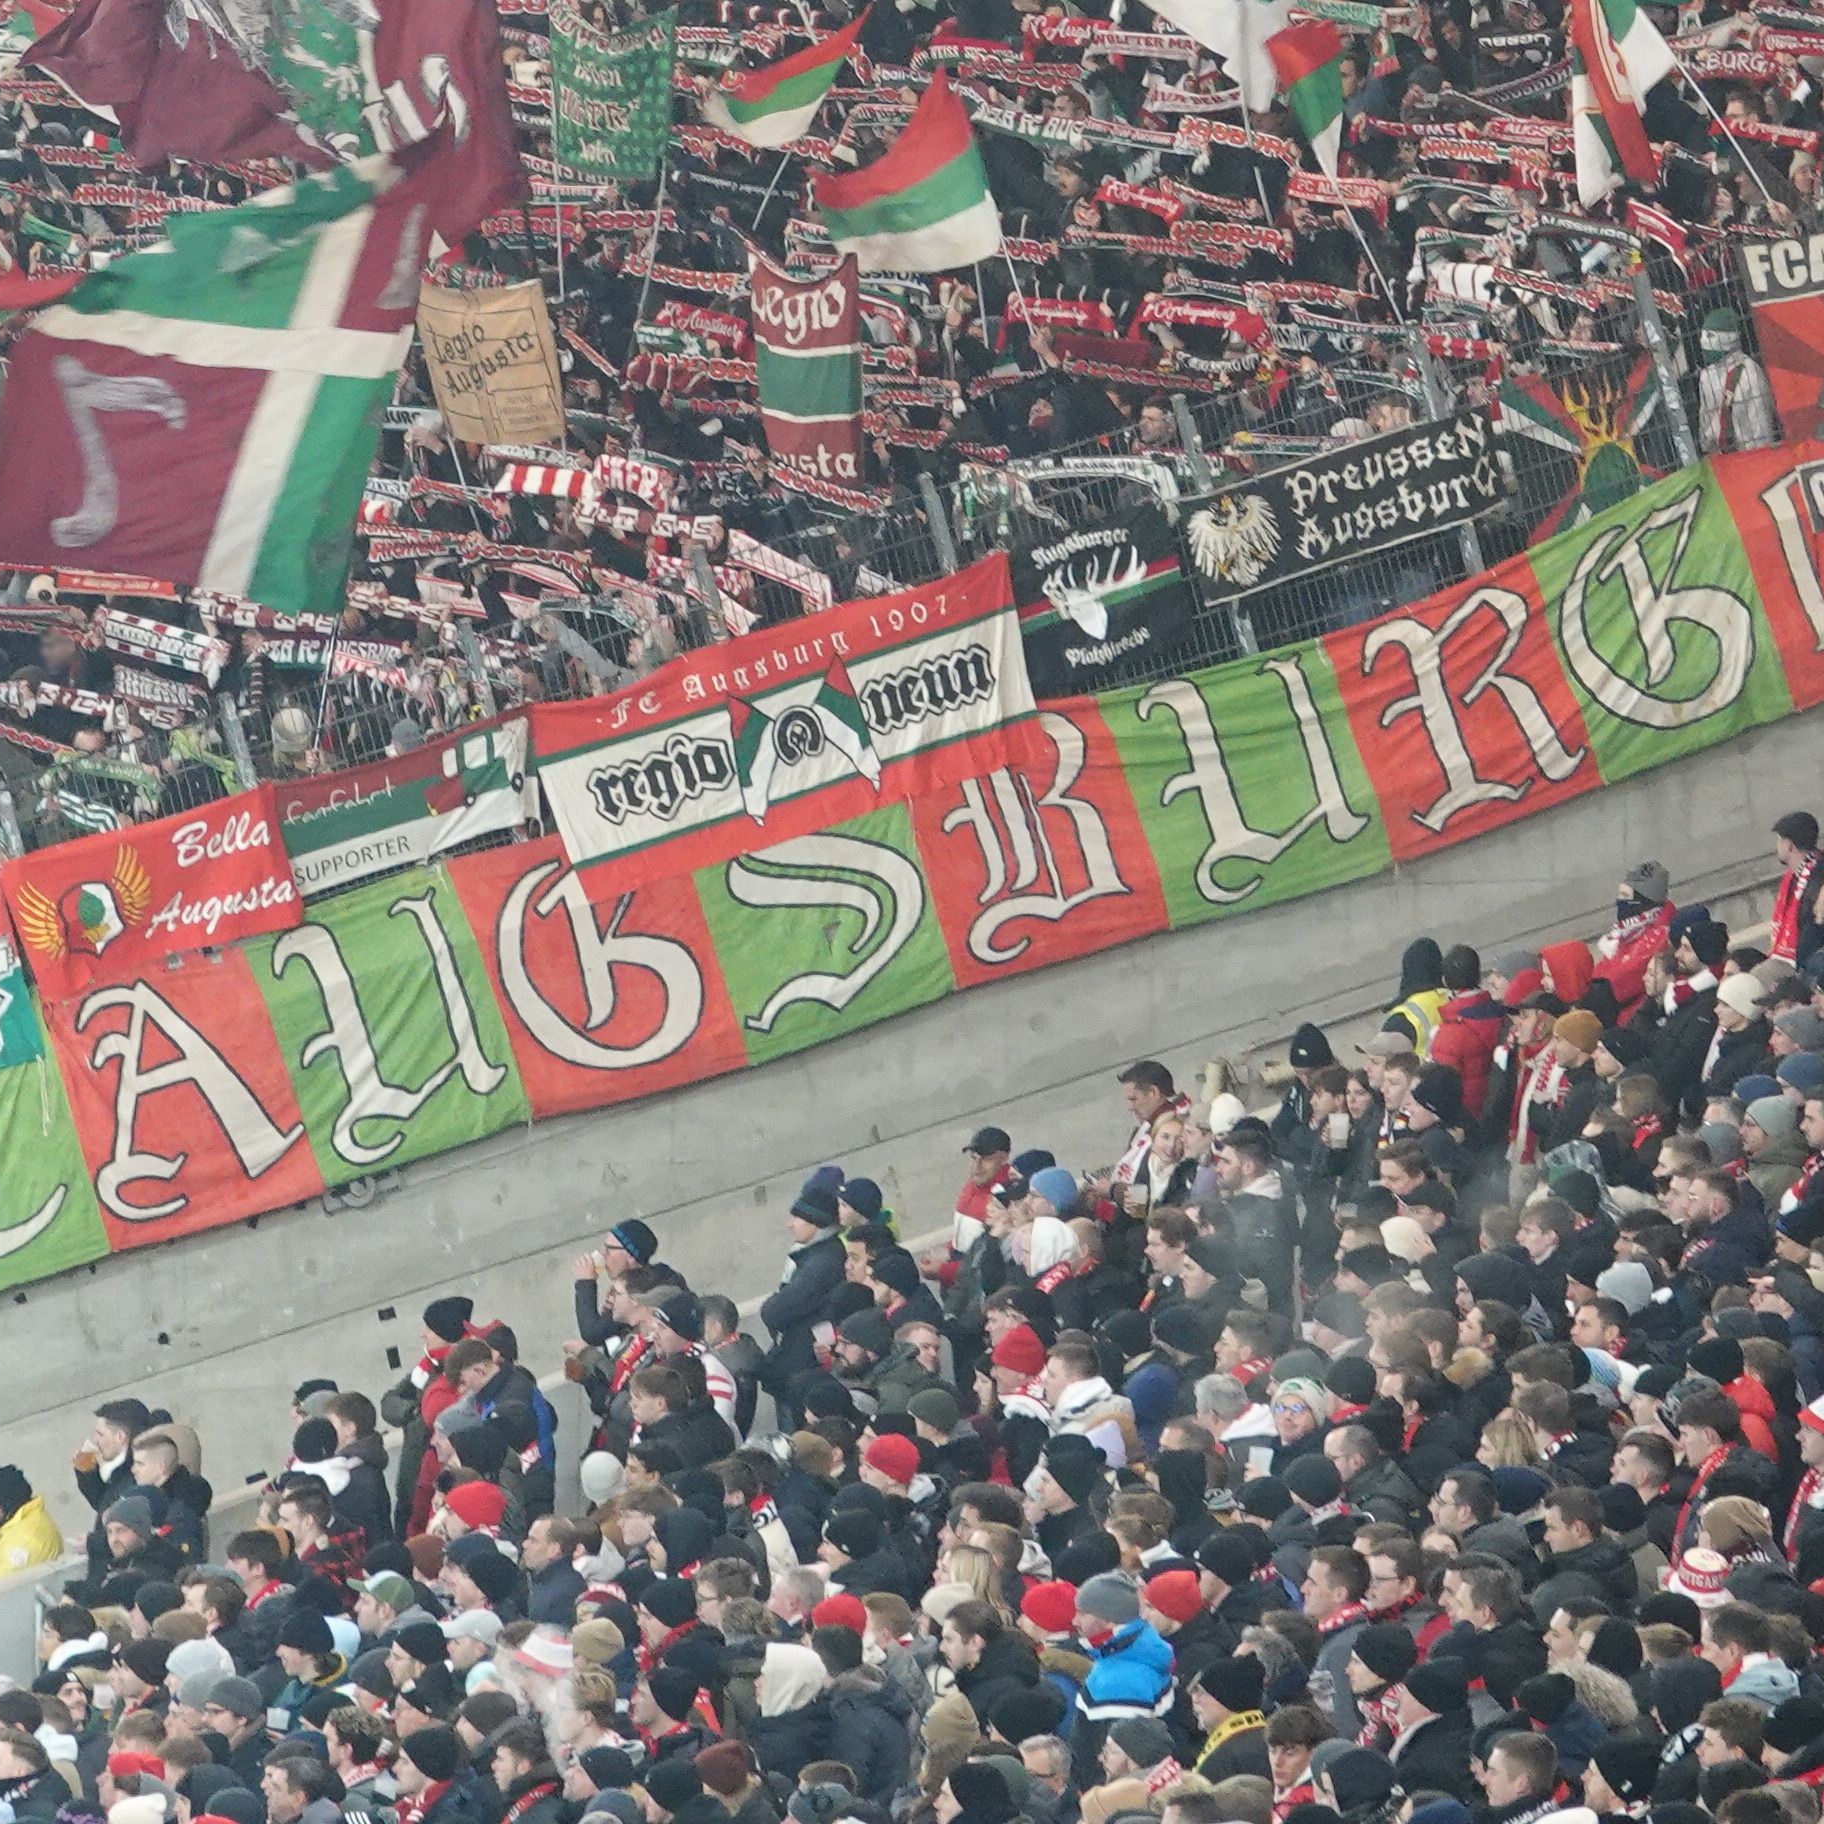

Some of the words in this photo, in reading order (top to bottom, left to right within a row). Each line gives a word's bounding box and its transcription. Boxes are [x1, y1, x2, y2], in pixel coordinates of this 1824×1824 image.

[428, 324, 485, 365] Legio
[445, 330, 535, 397] Augusta
[610, 690, 663, 729] FC
[682, 630, 849, 702] Augsburg
[869, 598, 948, 638] 1907
[587, 734, 734, 824] regio
[174, 810, 272, 871] Bella
[292, 834, 412, 885] SUPPORTER
[146, 874, 297, 939] Augusta
